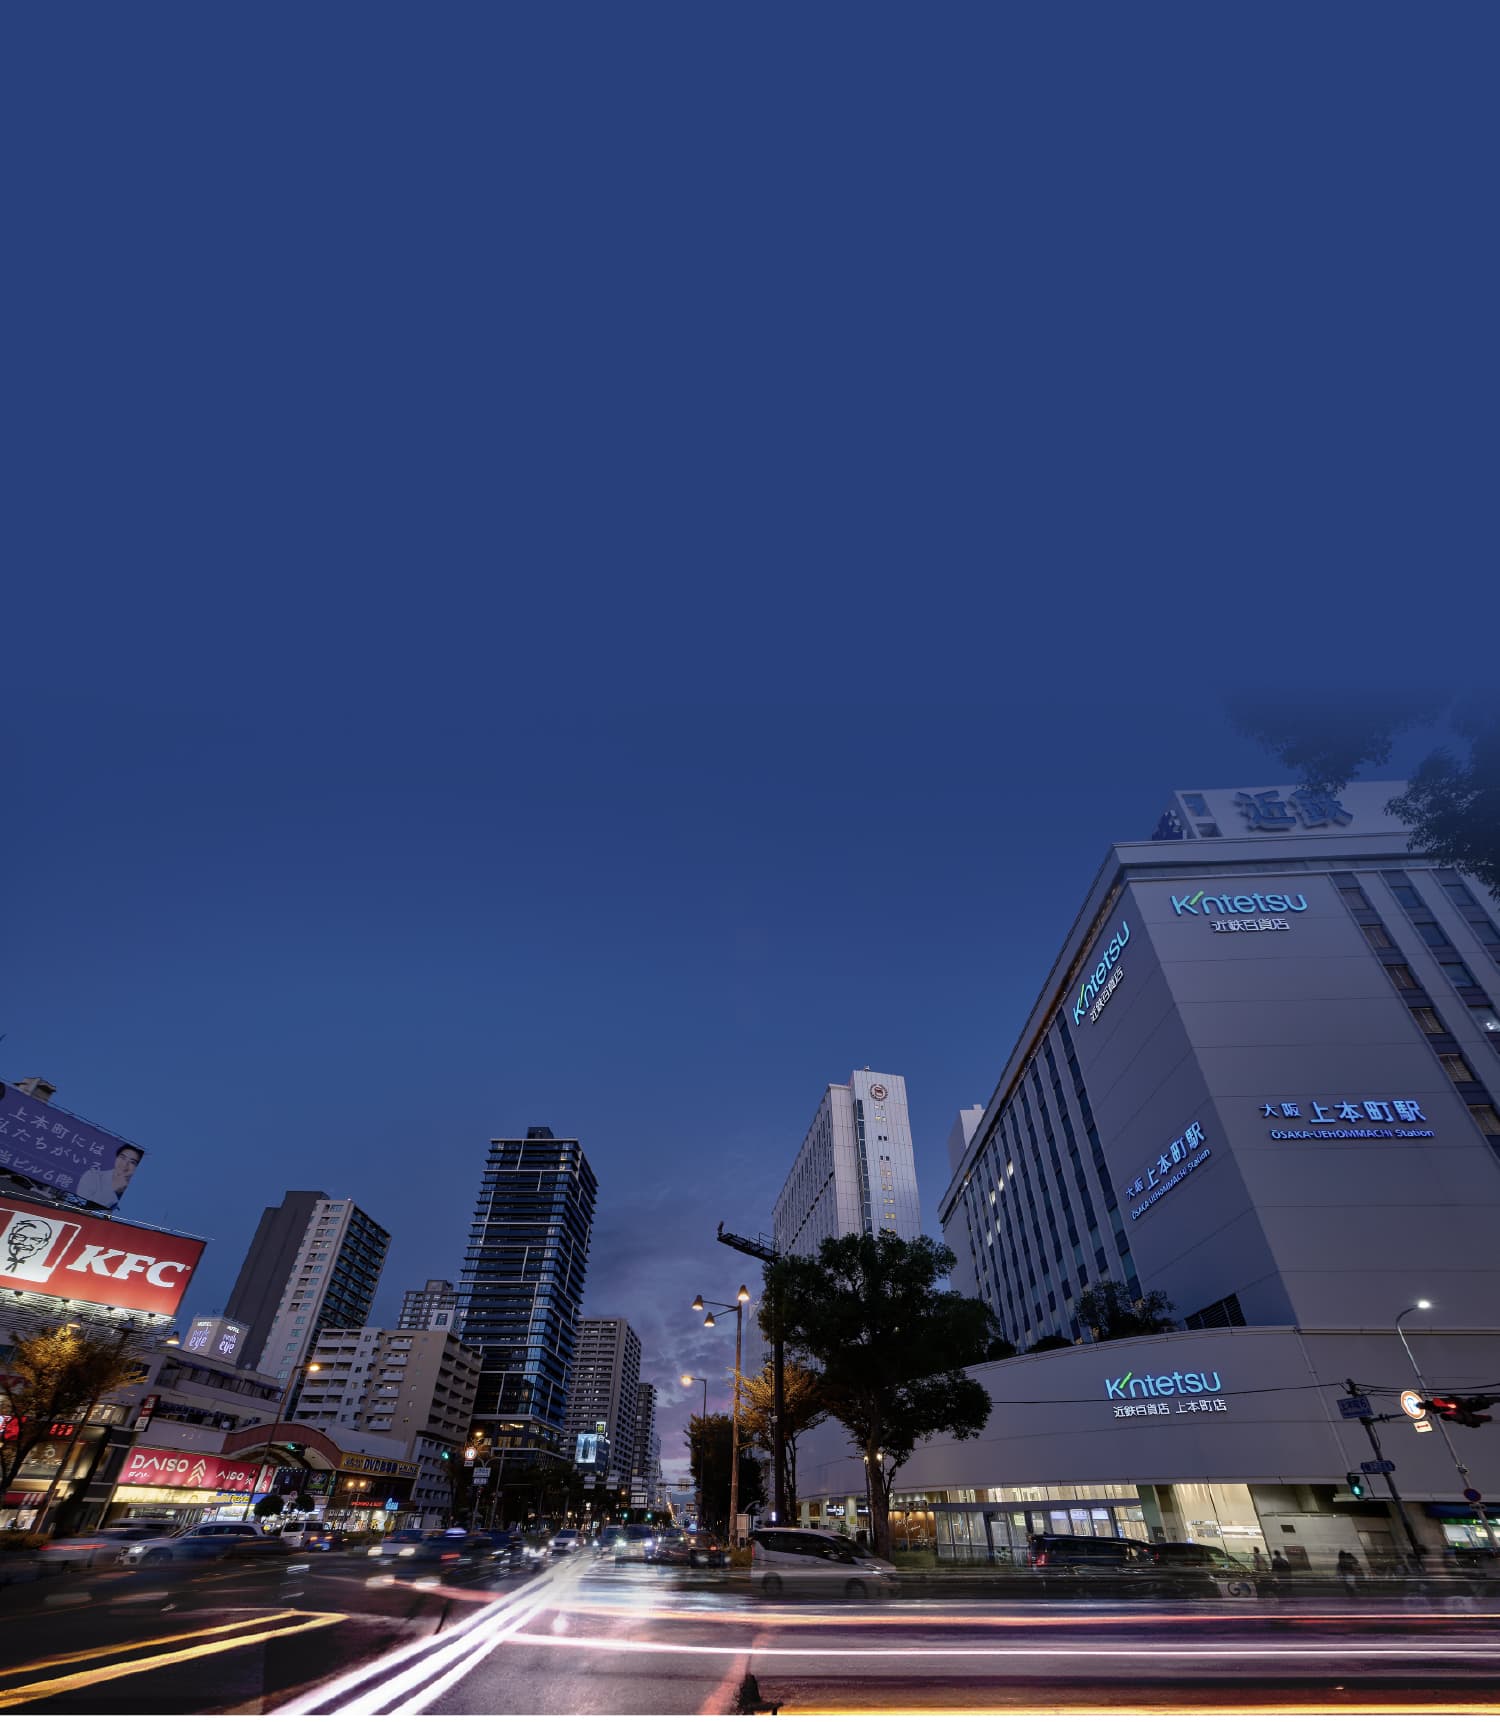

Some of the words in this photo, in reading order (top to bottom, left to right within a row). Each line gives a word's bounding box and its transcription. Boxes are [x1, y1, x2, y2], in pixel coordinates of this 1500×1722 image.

[1210, 917, 1290, 932] 近鉄百貨店
[1259, 1102, 1303, 1118] 大阪
[1309, 1099, 1427, 1123] 上本町駅
[8, 1106, 104, 1156] 上本町には
[1395, 1128, 1434, 1138] Station
[1147, 1121, 1205, 1190] 上本町駅
[66, 1244, 185, 1288] KFC
[189, 1336, 207, 1351] eye
[219, 1341, 235, 1354] eye
[1113, 1402, 1170, 1418] 近鉄百貨店
[1176, 1398, 1227, 1414] 上本町店
[130, 1454, 189, 1473] DAISO
